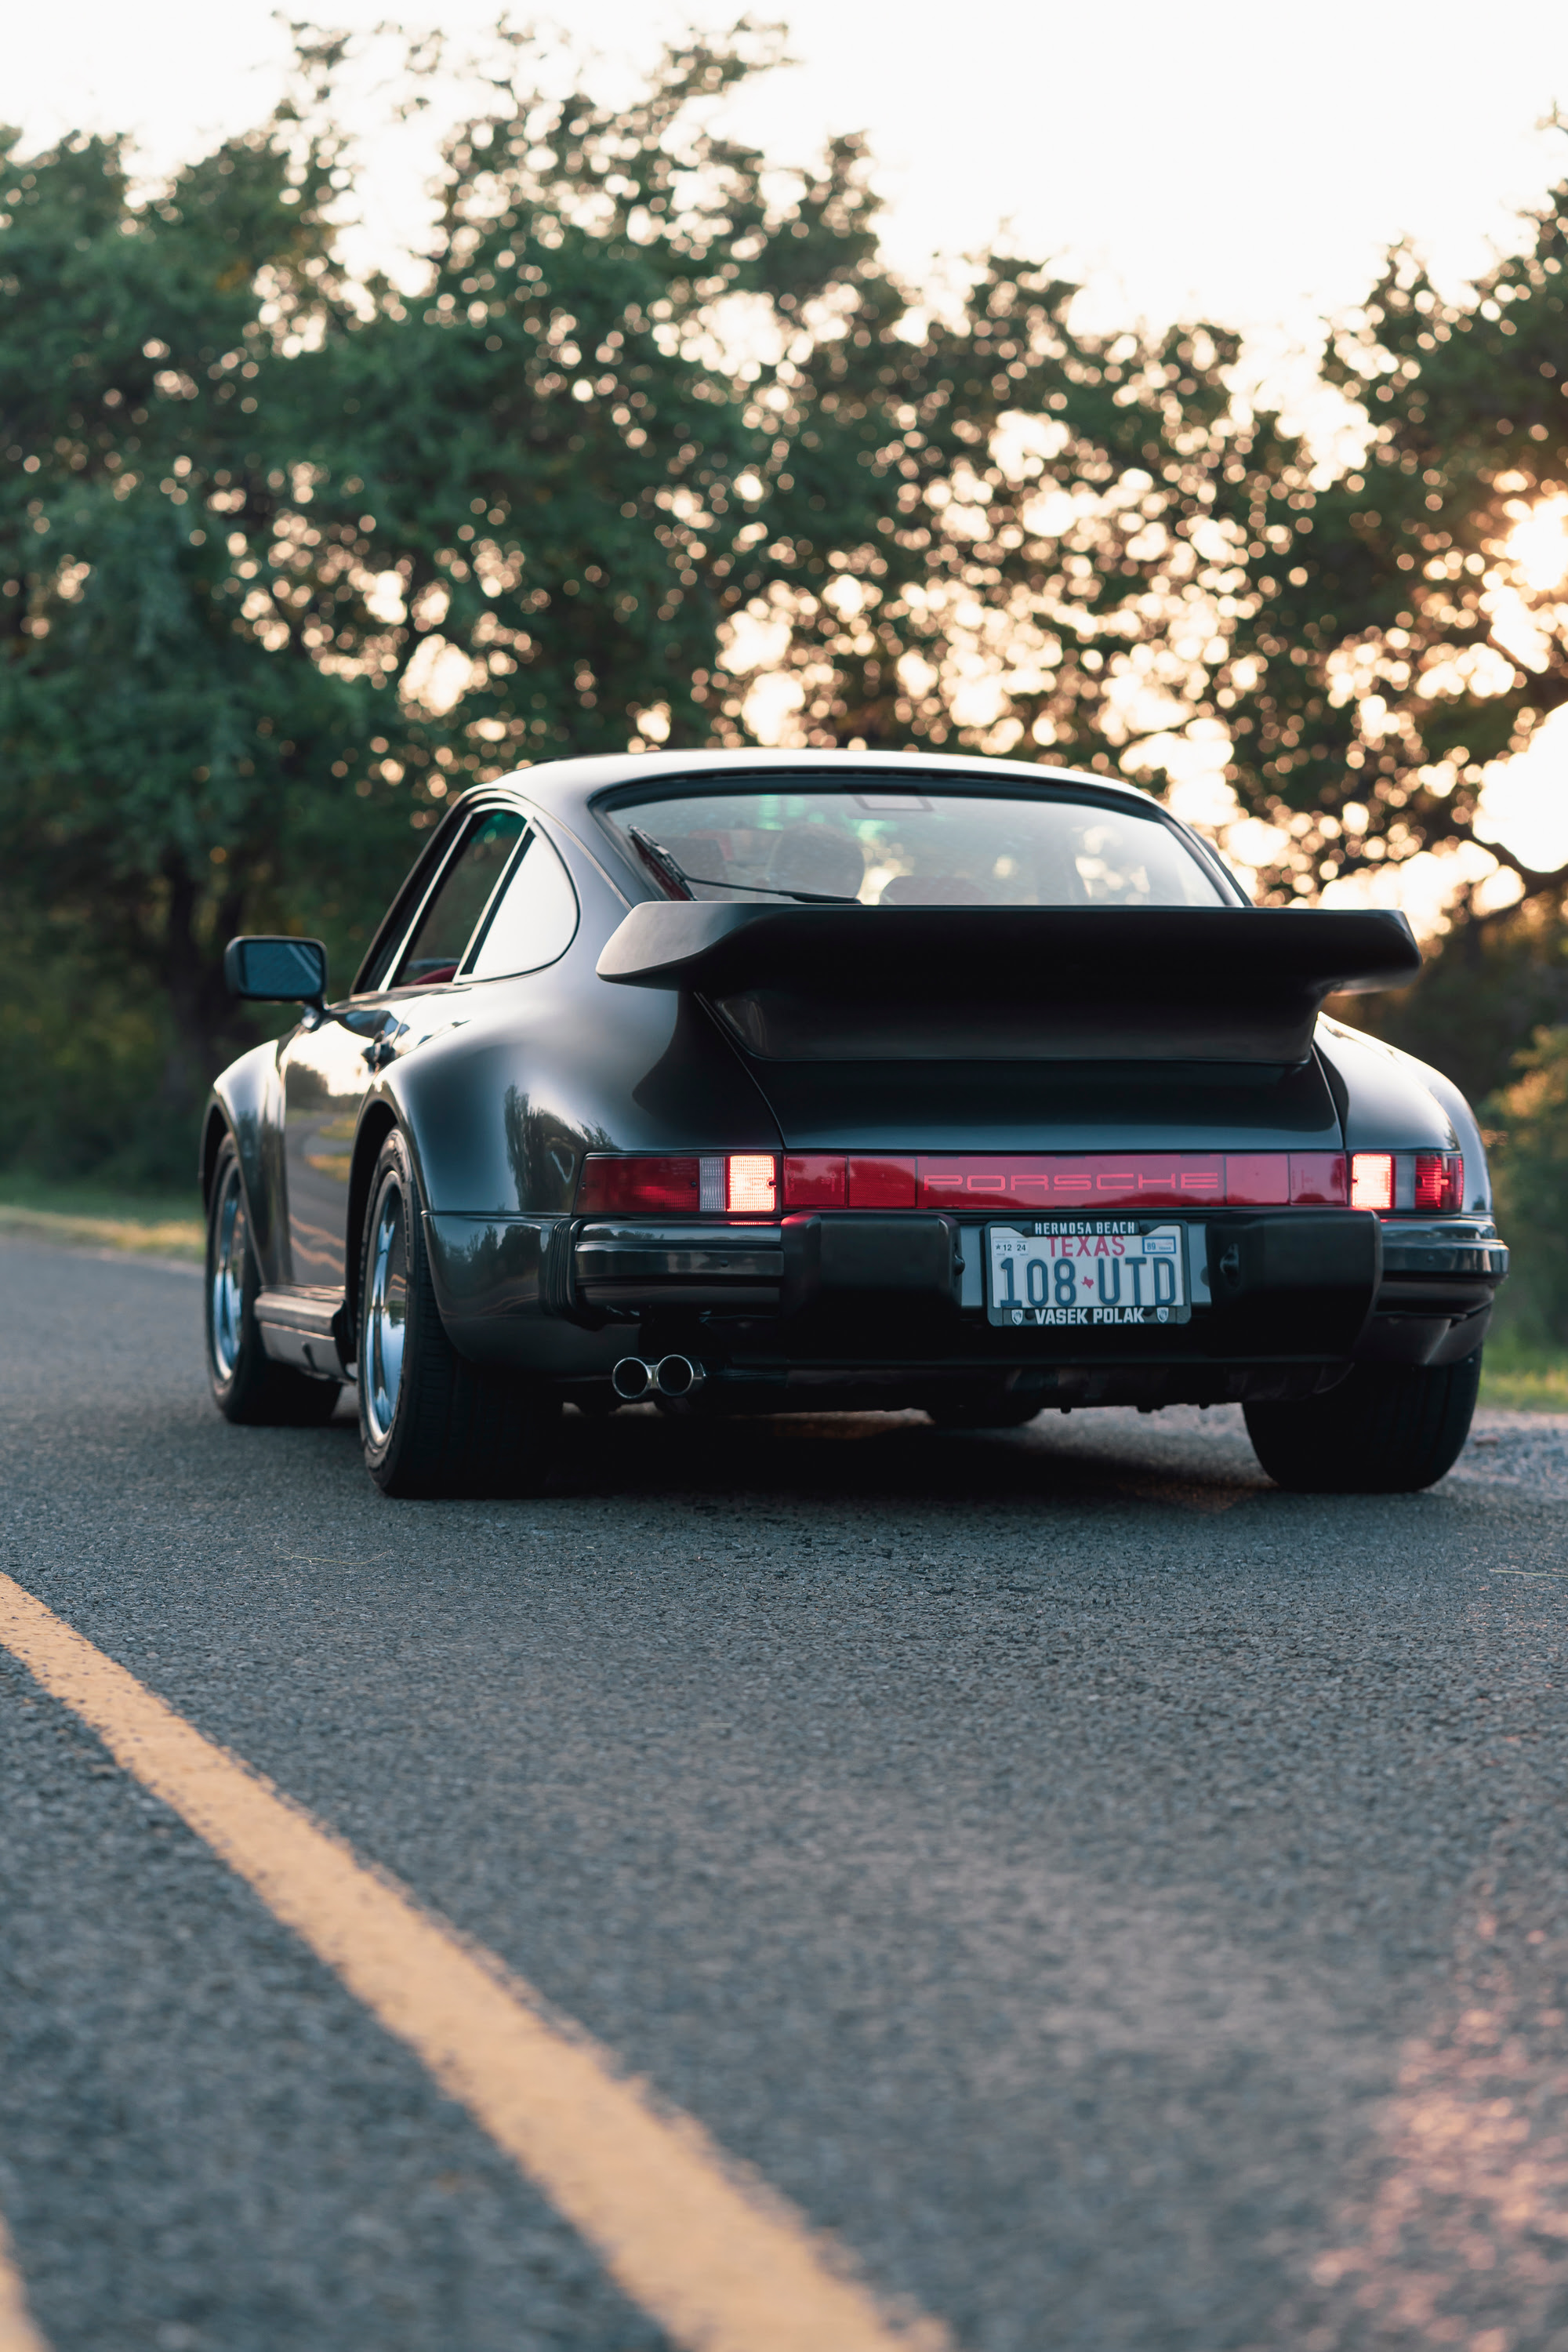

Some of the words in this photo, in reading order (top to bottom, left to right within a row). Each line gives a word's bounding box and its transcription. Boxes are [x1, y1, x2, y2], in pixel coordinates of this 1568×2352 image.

[924, 1173, 1218, 1191] PORSCHE
[1035, 1222, 1092, 1235] HERMOSA
[1096, 1221, 1135, 1234] BEACH
[1047, 1236, 1125, 1257] TEXAS
[1000, 1258, 1076, 1308] 108
[1098, 1257, 1176, 1306] UTD
[1035, 1308, 1088, 1325] VASEK
[1093, 1307, 1145, 1324] POLAK
